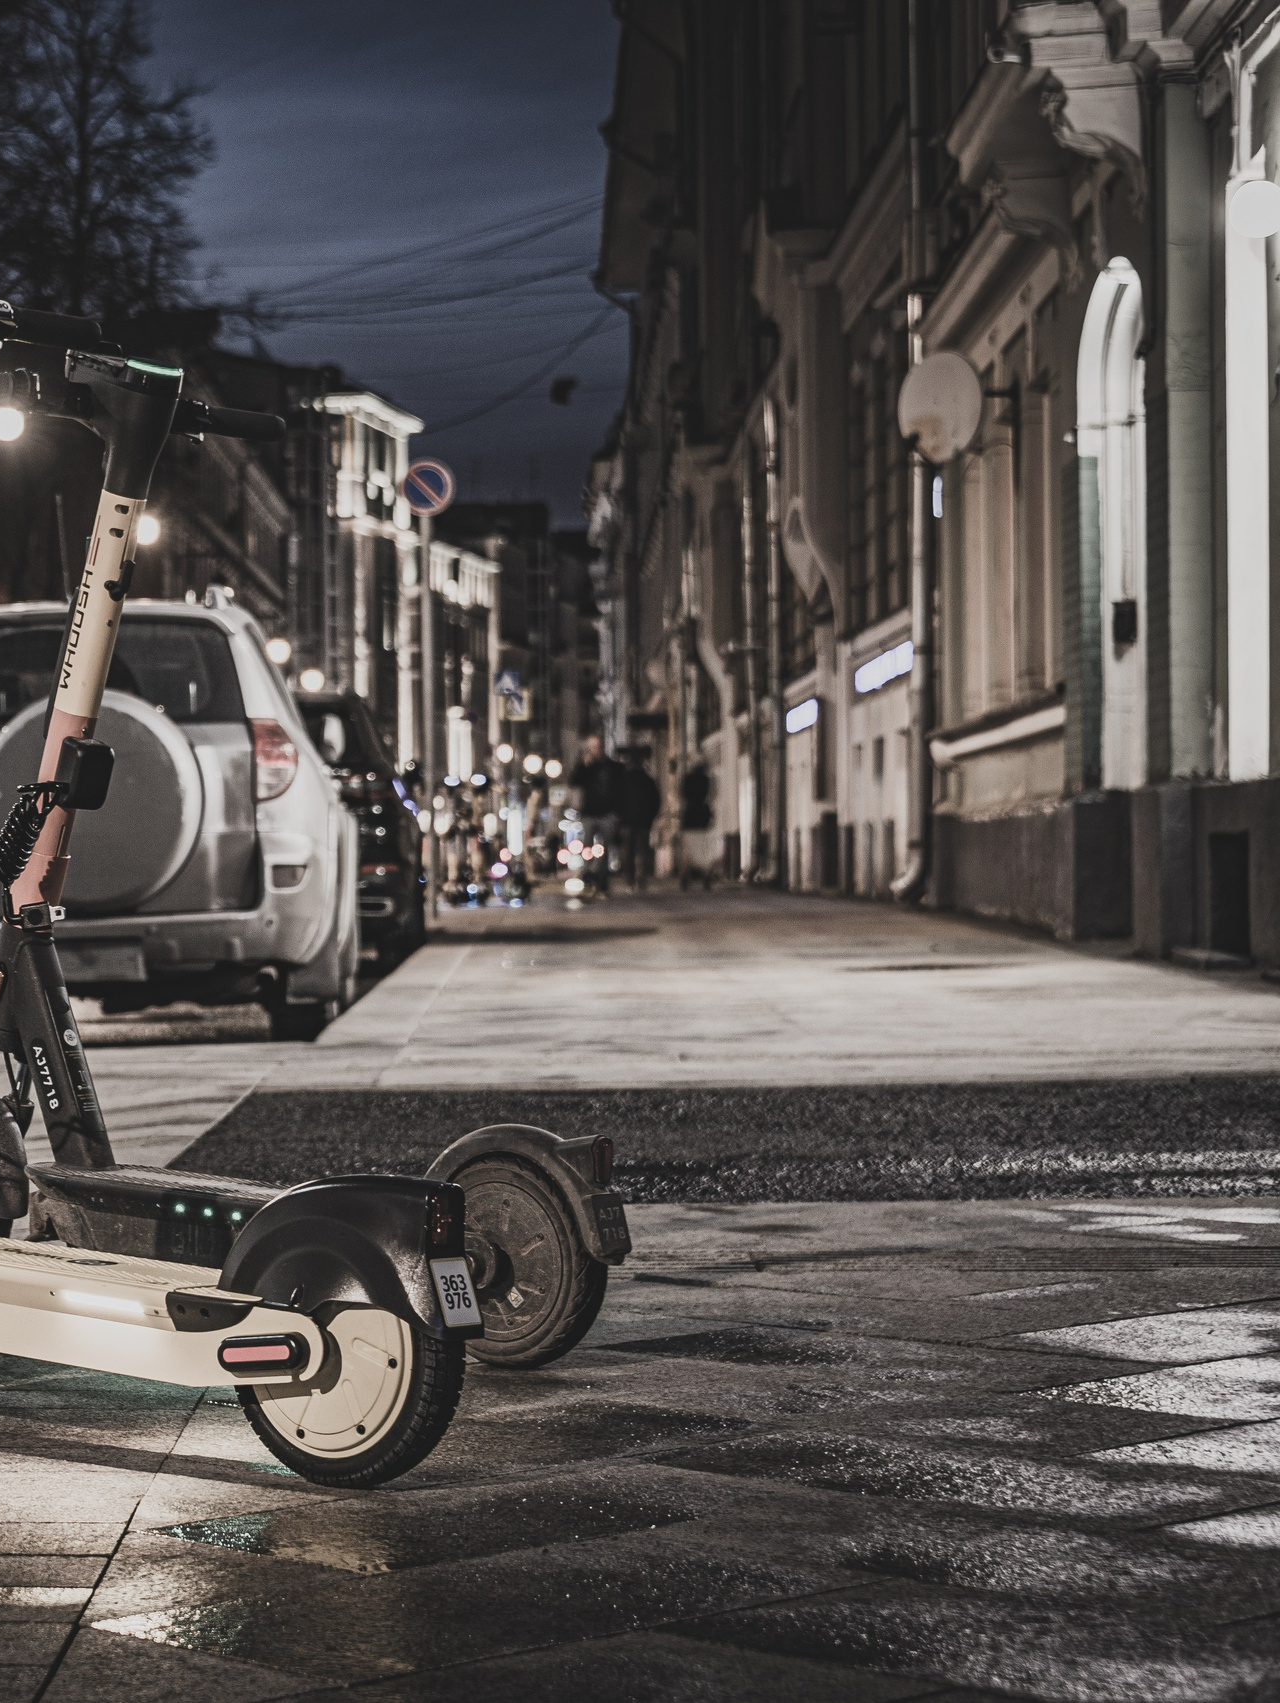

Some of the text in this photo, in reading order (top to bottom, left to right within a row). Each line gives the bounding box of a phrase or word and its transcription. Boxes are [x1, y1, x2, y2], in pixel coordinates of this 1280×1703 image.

[59, 569, 94, 689] WHOOSH
[32, 1046, 59, 1110] AJ7718
[599, 1206, 621, 1221] AJ7
[602, 1227, 626, 1241] 718
[440, 1273, 467, 1292] 363
[445, 1291, 472, 1310] 976
